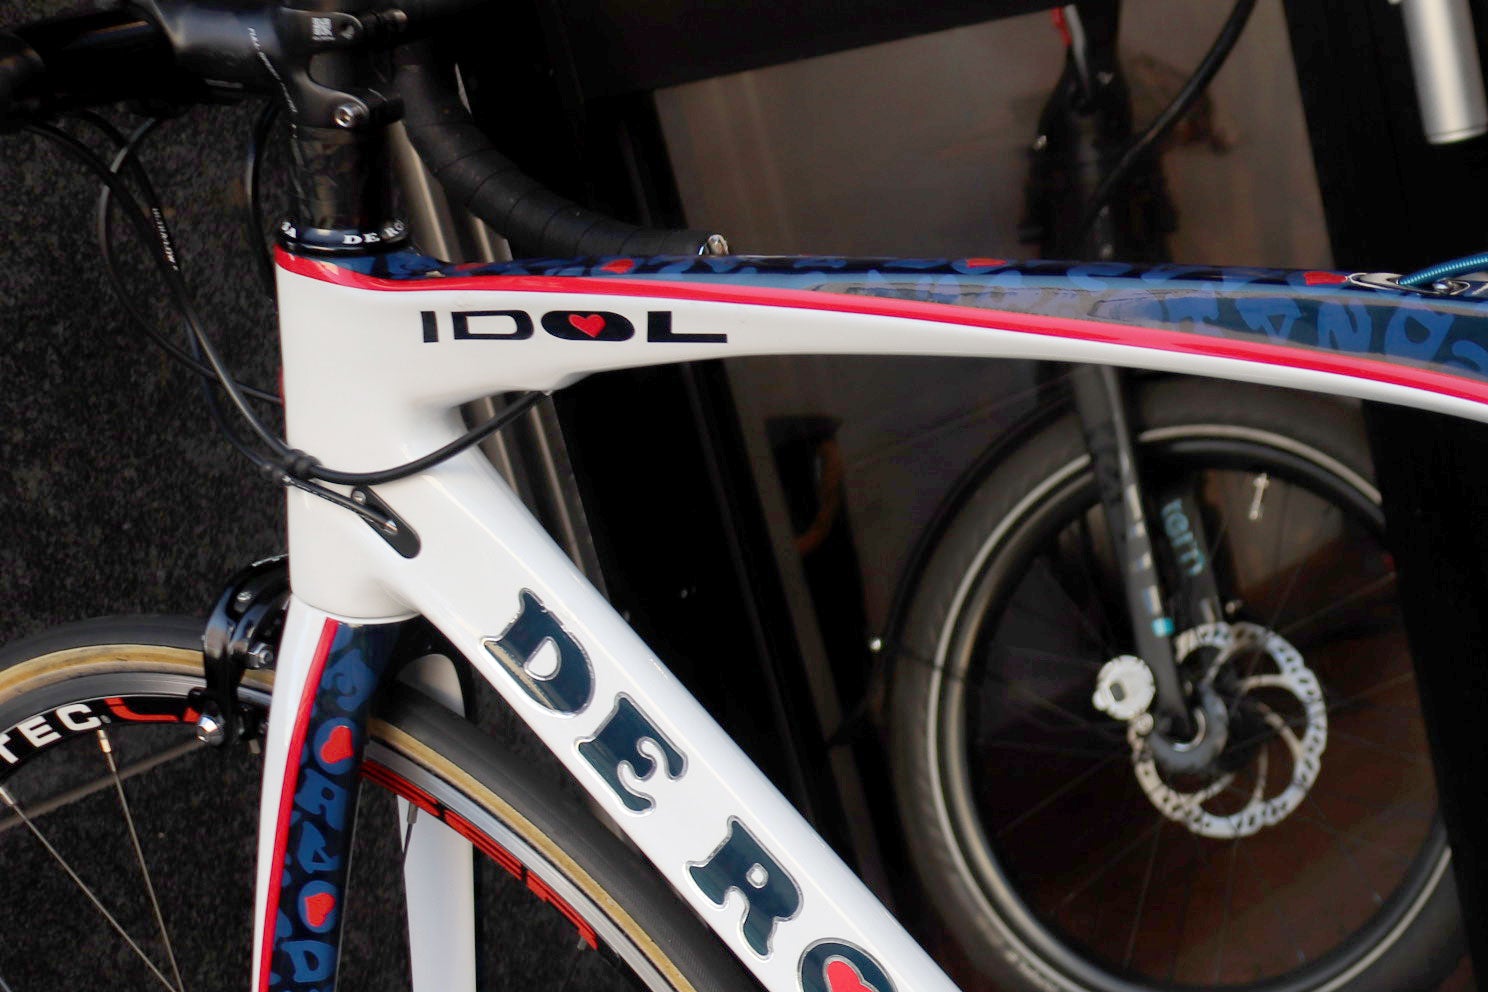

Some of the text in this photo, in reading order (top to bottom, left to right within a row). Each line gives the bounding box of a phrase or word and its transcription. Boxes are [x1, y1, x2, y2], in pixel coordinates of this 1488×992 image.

[342, 233, 381, 245] DE
[420, 309, 728, 343] IDOL
[480, 587, 688, 817] DE
